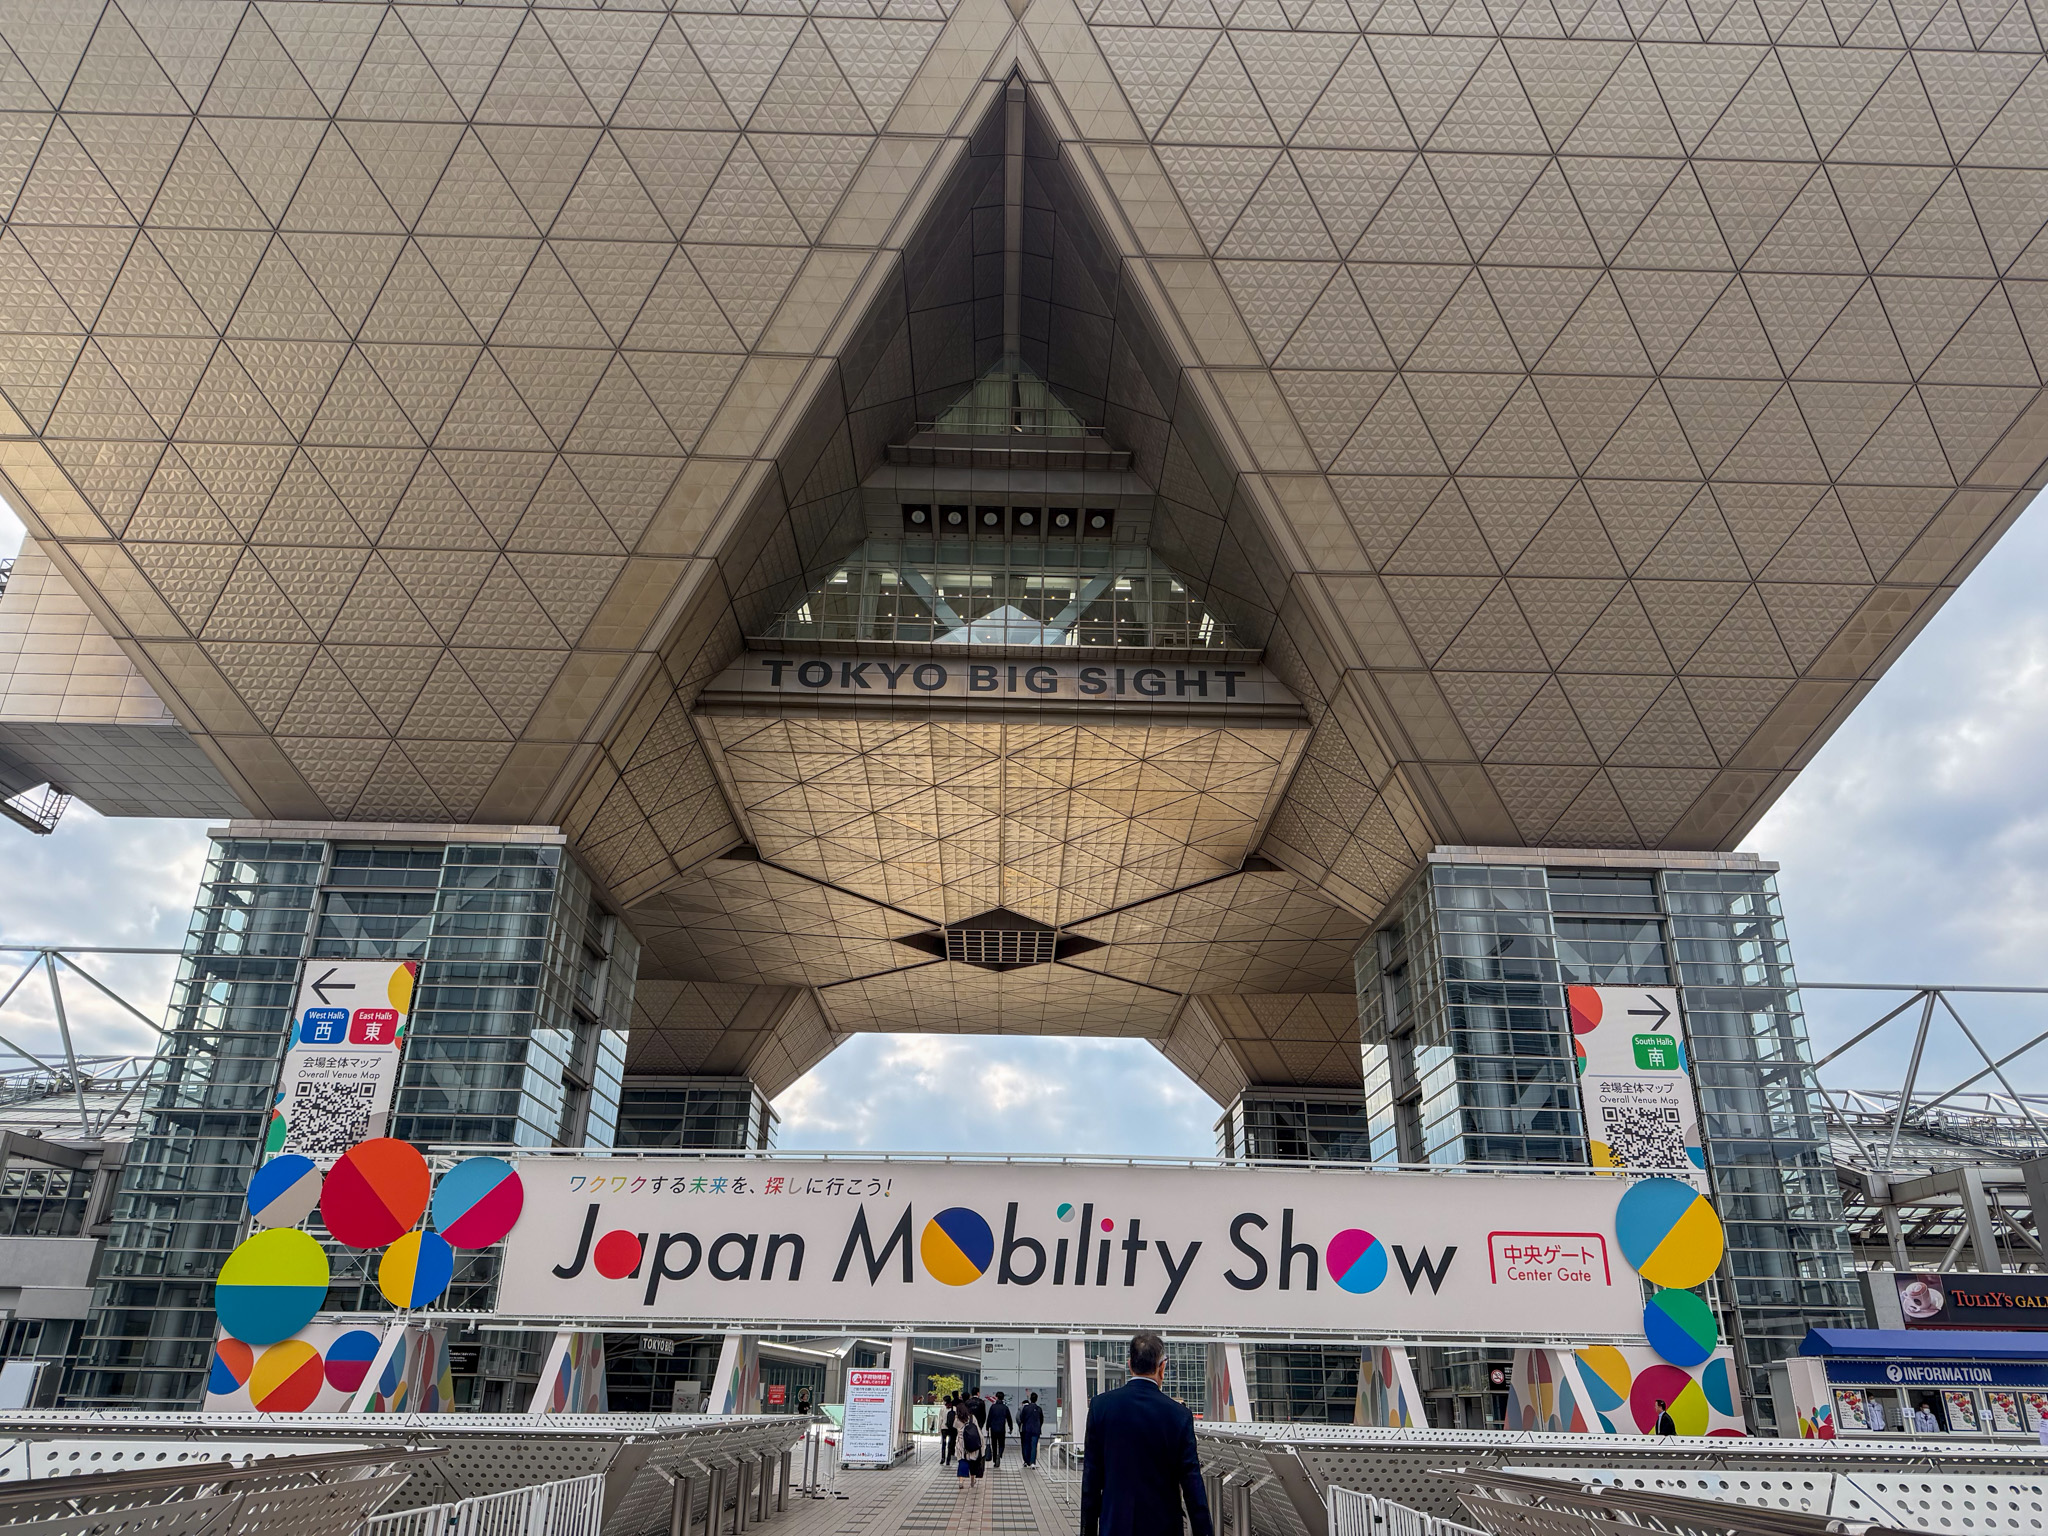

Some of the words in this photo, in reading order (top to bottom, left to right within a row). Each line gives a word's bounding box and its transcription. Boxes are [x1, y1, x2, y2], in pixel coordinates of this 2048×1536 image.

[761, 659, 948, 691] TOKYO
[968, 665, 1058, 694] BIG
[1078, 667, 1246, 698] SIGHT
[309, 1011, 327, 1020] West
[327, 1011, 345, 1020] Halls
[359, 1012, 375, 1020] East
[375, 1012, 393, 1020] Halls
[314, 1021, 334, 1041] 西
[363, 1021, 383, 1042] 東
[1634, 1037, 1655, 1045] South
[1656, 1038, 1673, 1046] Halls
[303, 1056, 382, 1069] 会場全体マップ
[1647, 1047, 1666, 1067] 南
[298, 1070, 330, 1079] Overall
[332, 1070, 358, 1079] Venue
[360, 1071, 381, 1081] Map
[1599, 1081, 1675, 1094] 会場全体マップ
[1599, 1095, 1630, 1104] Overall
[1632, 1096, 1658, 1104] Venue
[1660, 1097, 1680, 1106] Map
[551, 1203, 806, 1306] Japan
[1223, 1208, 1458, 1296] Show
[1503, 1245, 1596, 1266] 中央ゲート
[1507, 1267, 1553, 1282] Center
[1557, 1268, 1592, 1283] Gate
[643, 1337, 665, 1351] TOKYO
[1903, 1366, 1993, 1382] INFORMATION
